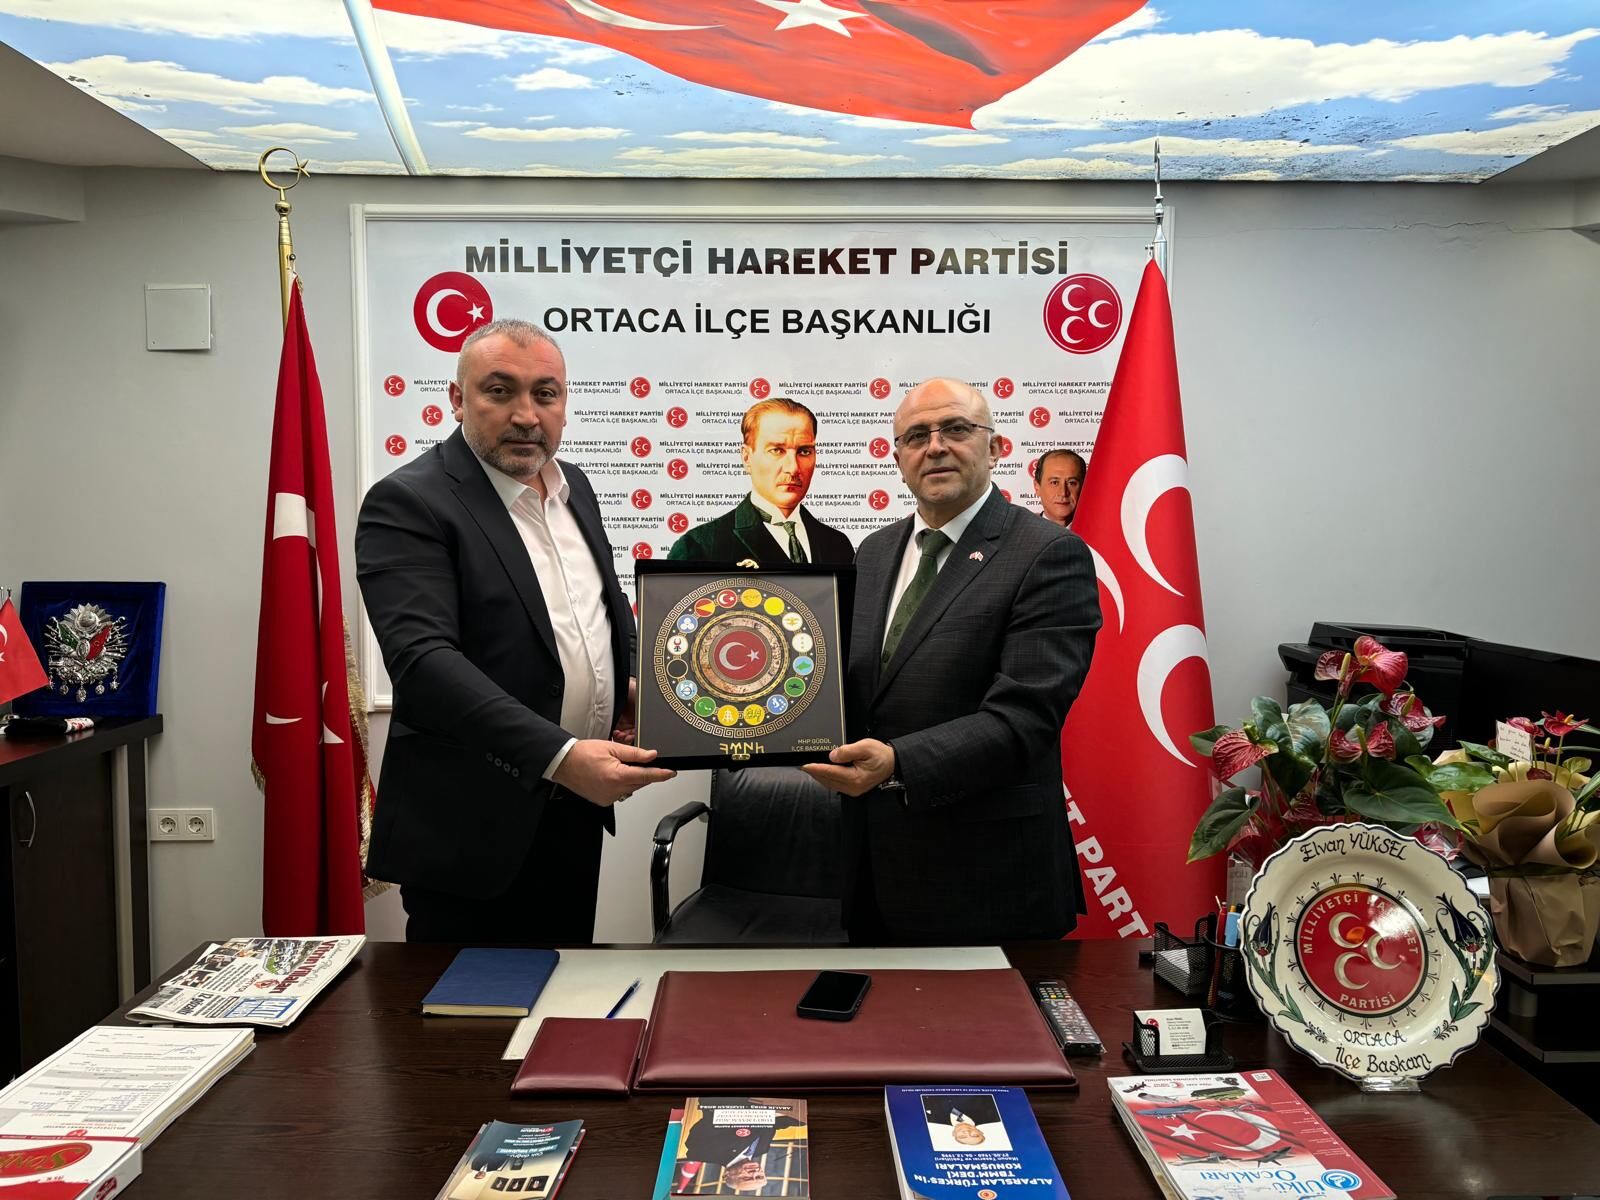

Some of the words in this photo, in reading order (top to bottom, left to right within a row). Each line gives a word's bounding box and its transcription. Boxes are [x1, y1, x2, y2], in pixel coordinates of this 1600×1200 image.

[465, 238, 692, 277] MİLLİYETÇİ
[708, 247, 897, 275] HAREKET
[911, 240, 1068, 275] PARTİSİ
[543, 307, 686, 333] ORTACA
[695, 302, 770, 339] İLÇE
[782, 302, 990, 339] BAŞKANLIĞI
[1300, 838, 1345, 862] Elvan
[1350, 832, 1406, 861] YÜKSEL
[1075, 835, 1151, 938] PART
[1303, 893, 1359, 954] MİLLİYETÇİ
[304, 940, 338, 964] Vitrin
[1339, 991, 1396, 1010] PARTİSİ
[1343, 1028, 1407, 1044] ORTACA
[1336, 1046, 1361, 1070] İlçe
[1367, 1053, 1432, 1075] Başkanı
[935, 1162, 1022, 1171] KONUŞMALARI
[980, 1178, 1053, 1186] ALPARSLAN
[1272, 1180, 1325, 1195] Ülkü
